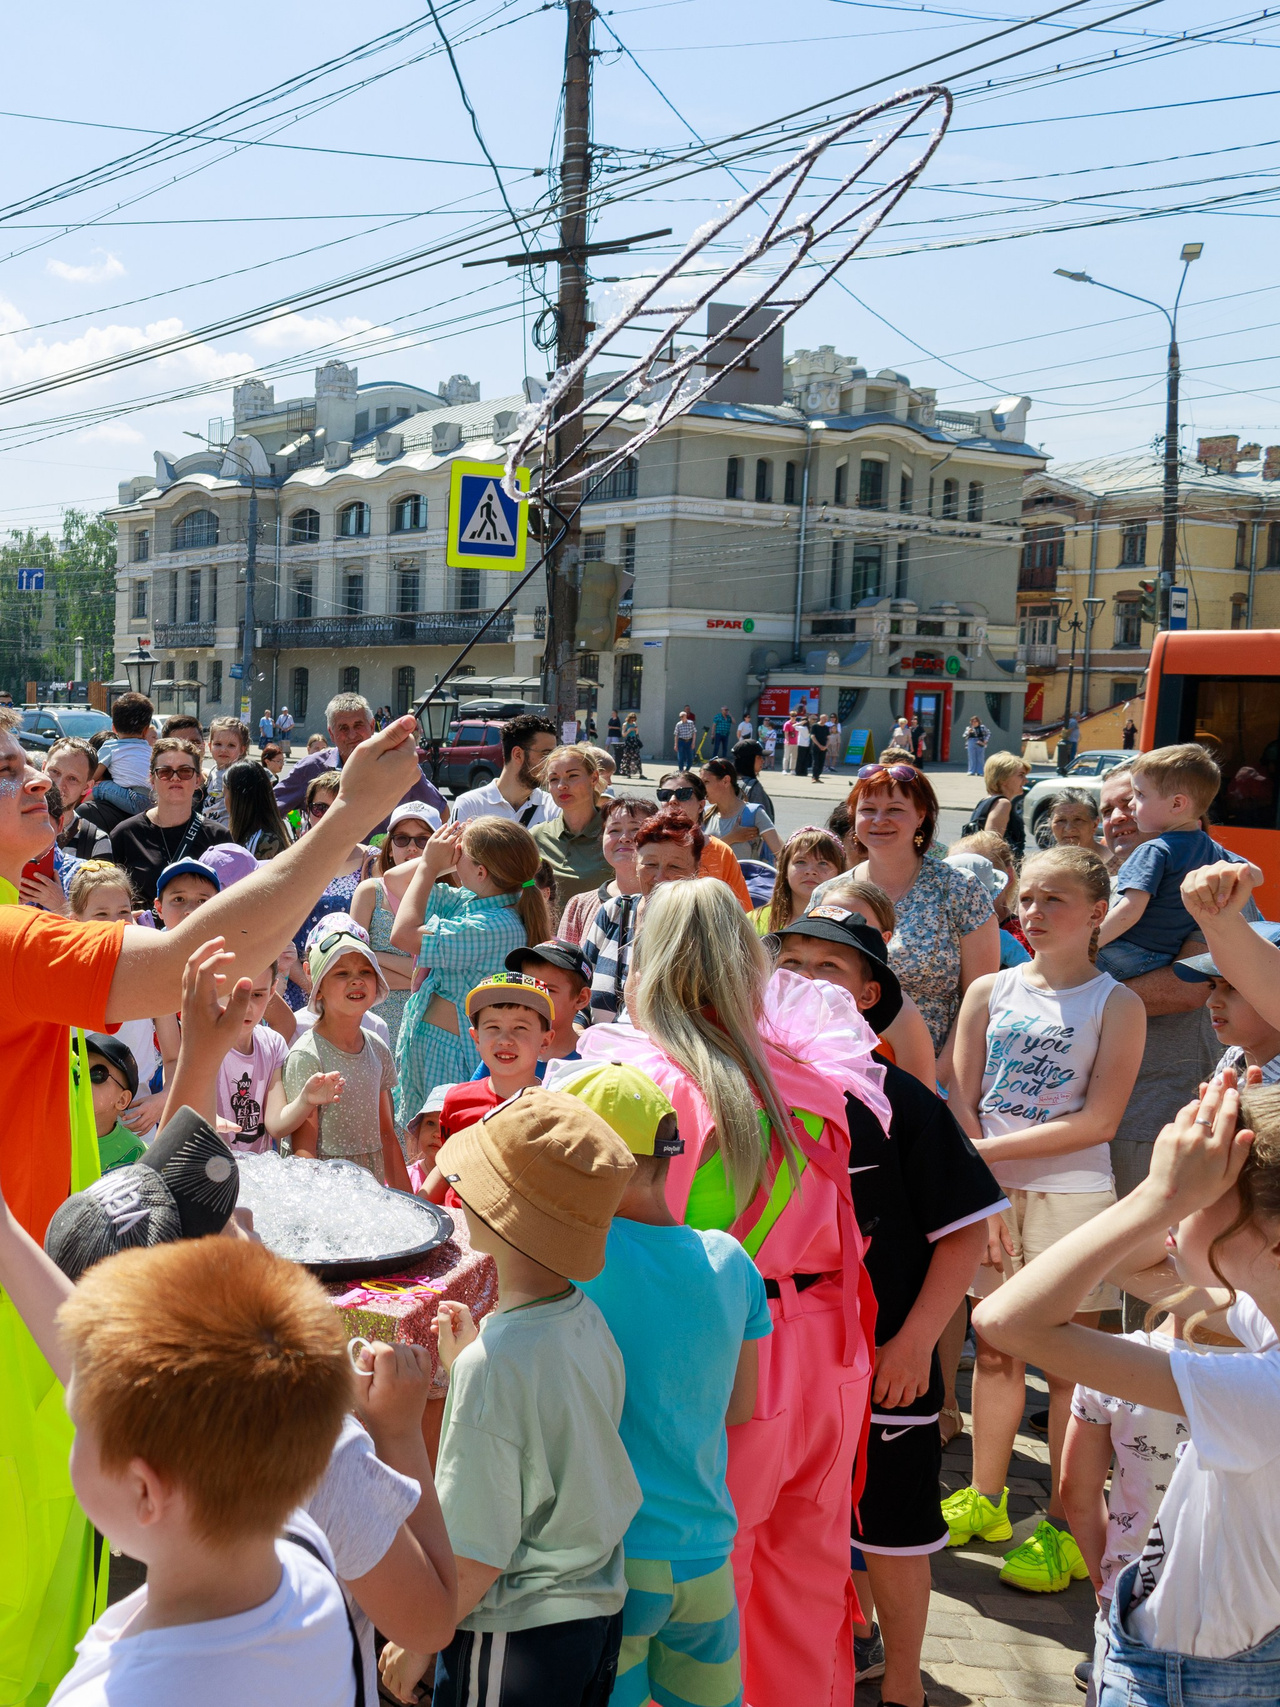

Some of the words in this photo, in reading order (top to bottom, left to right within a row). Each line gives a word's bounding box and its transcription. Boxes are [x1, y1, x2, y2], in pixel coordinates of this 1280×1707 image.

[706, 619, 742, 629] SPAR
[900, 656, 945, 670] SPAR
[996, 1010, 1043, 1033] Let
[1041, 1024, 1074, 1038] me
[987, 1031, 1021, 1055] tell
[1021, 1036, 1072, 1054] you
[995, 1071, 1046, 1096] bout
